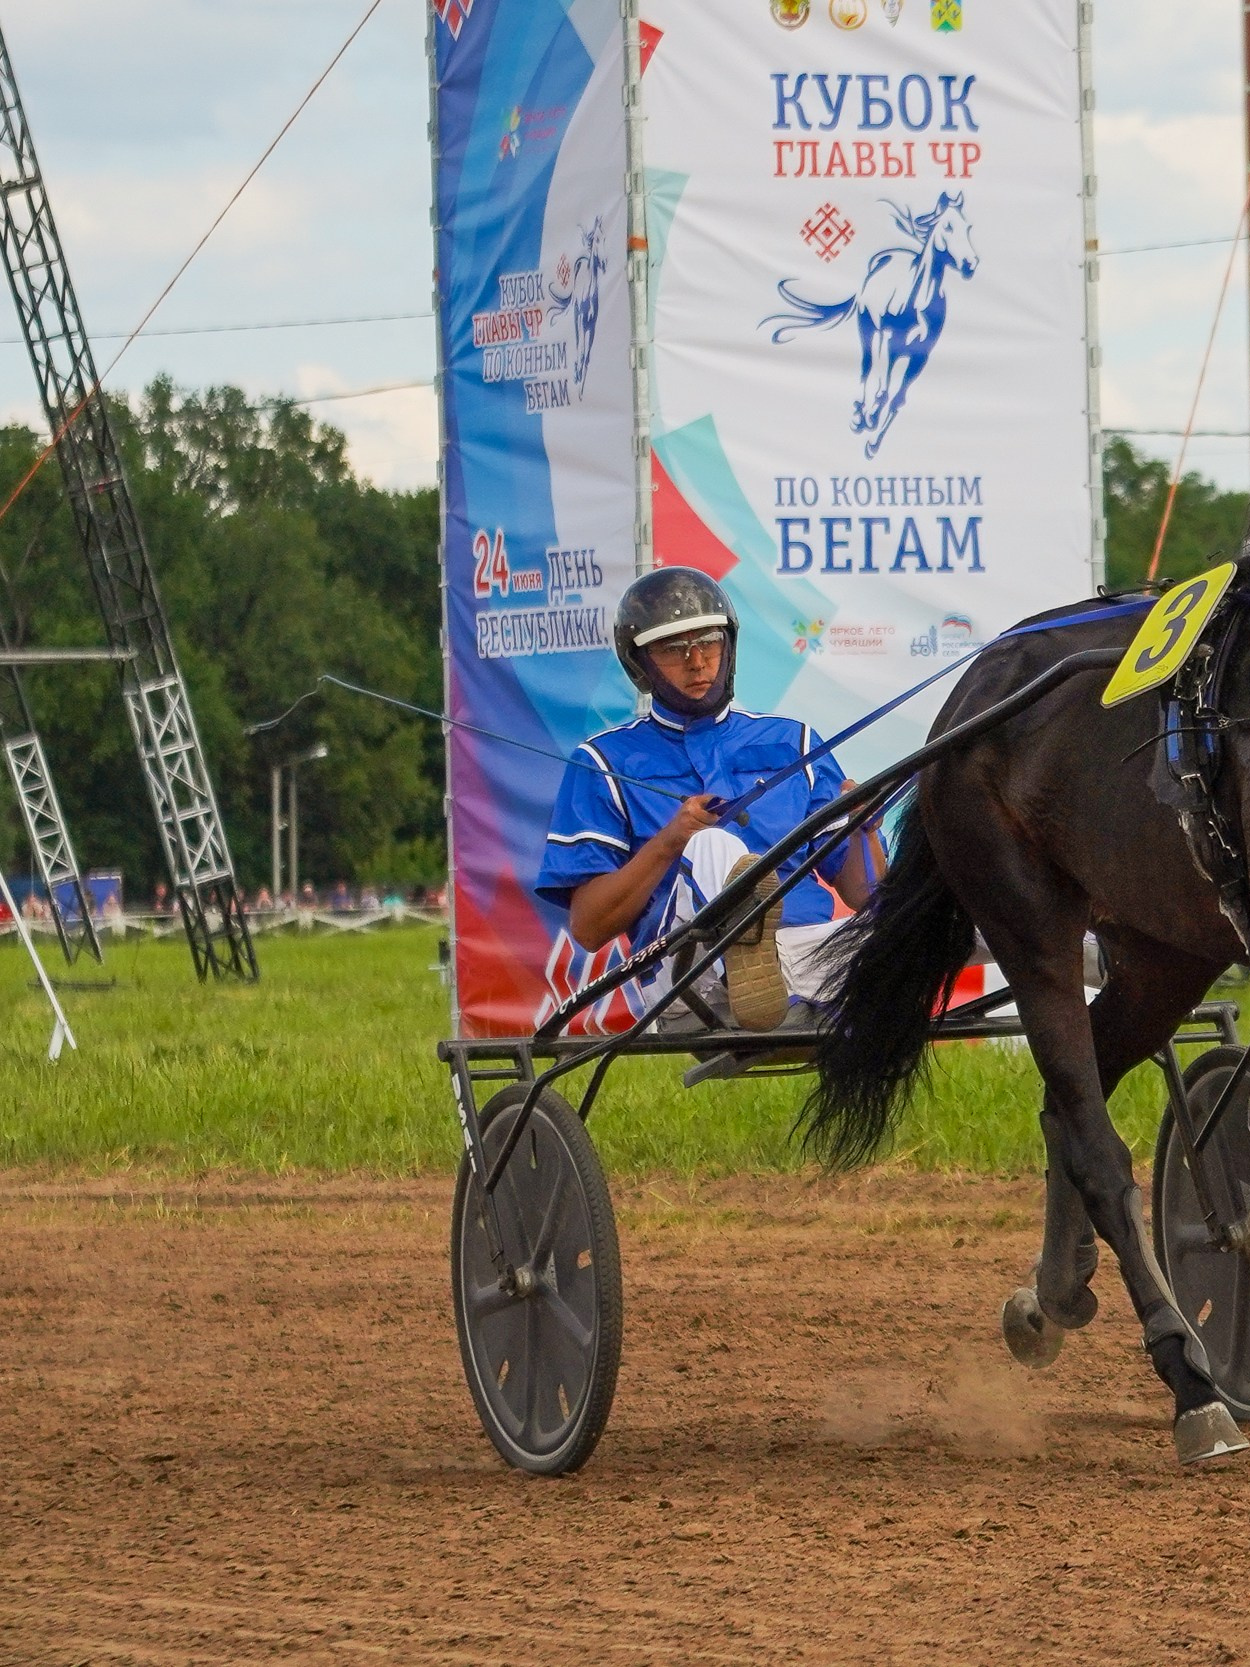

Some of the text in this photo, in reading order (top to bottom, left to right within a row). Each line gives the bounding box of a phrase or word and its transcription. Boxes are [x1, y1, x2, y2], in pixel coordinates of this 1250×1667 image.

[770, 73, 979, 132] КУБОК
[772, 141, 982, 179] ГЛАВЫ ЧР
[500, 274, 545, 306] КУБОК
[473, 309, 543, 345] ГЛАВЫ ЧР
[483, 341, 568, 380] ПО КОННЫМ
[524, 379, 571, 411] БЕГАМ
[774, 476, 984, 507] ПО КОННЫМ
[775, 517, 986, 575] БЕГАМ
[474, 534, 509, 593] 24
[548, 548, 603, 602] ДЕНЬ
[477, 606, 610, 655] РЕСПУБЛИКИ!
[829, 627, 895, 636] ЯРКОЕ ЛЕТО
[829, 638, 883, 648] ЧУВАШИИ
[1134, 580, 1209, 673] 3
